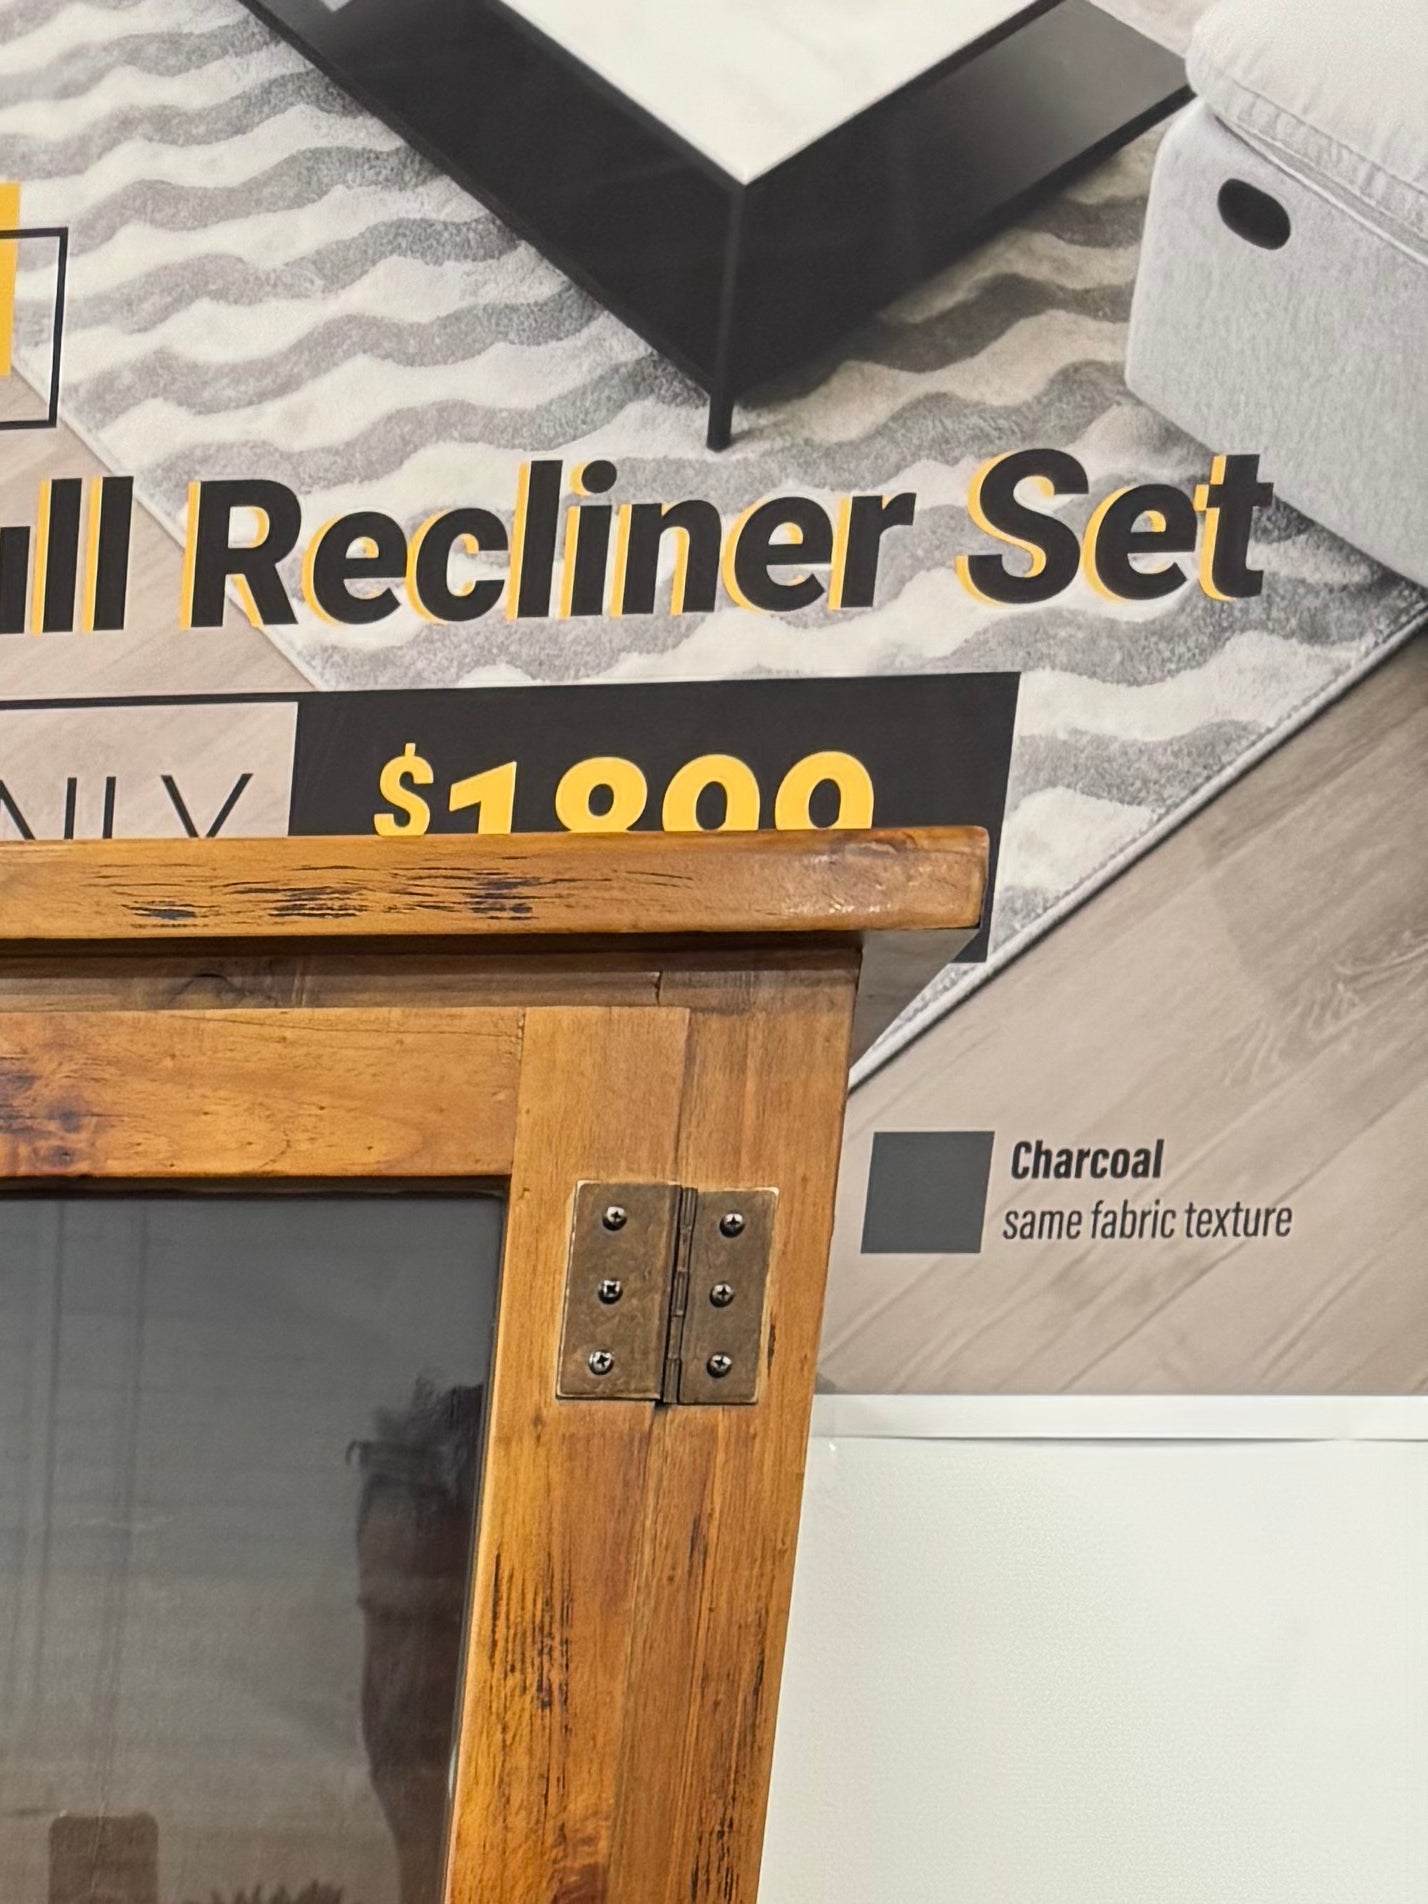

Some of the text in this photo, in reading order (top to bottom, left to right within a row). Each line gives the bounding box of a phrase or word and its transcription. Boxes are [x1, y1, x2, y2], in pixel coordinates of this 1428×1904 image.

[180, 459, 916, 631] Recliner
[955, 448, 1274, 604] Set
[1011, 1139, 1165, 1179] Charcoal
[1002, 1199, 1293, 1240] same fabric texture
